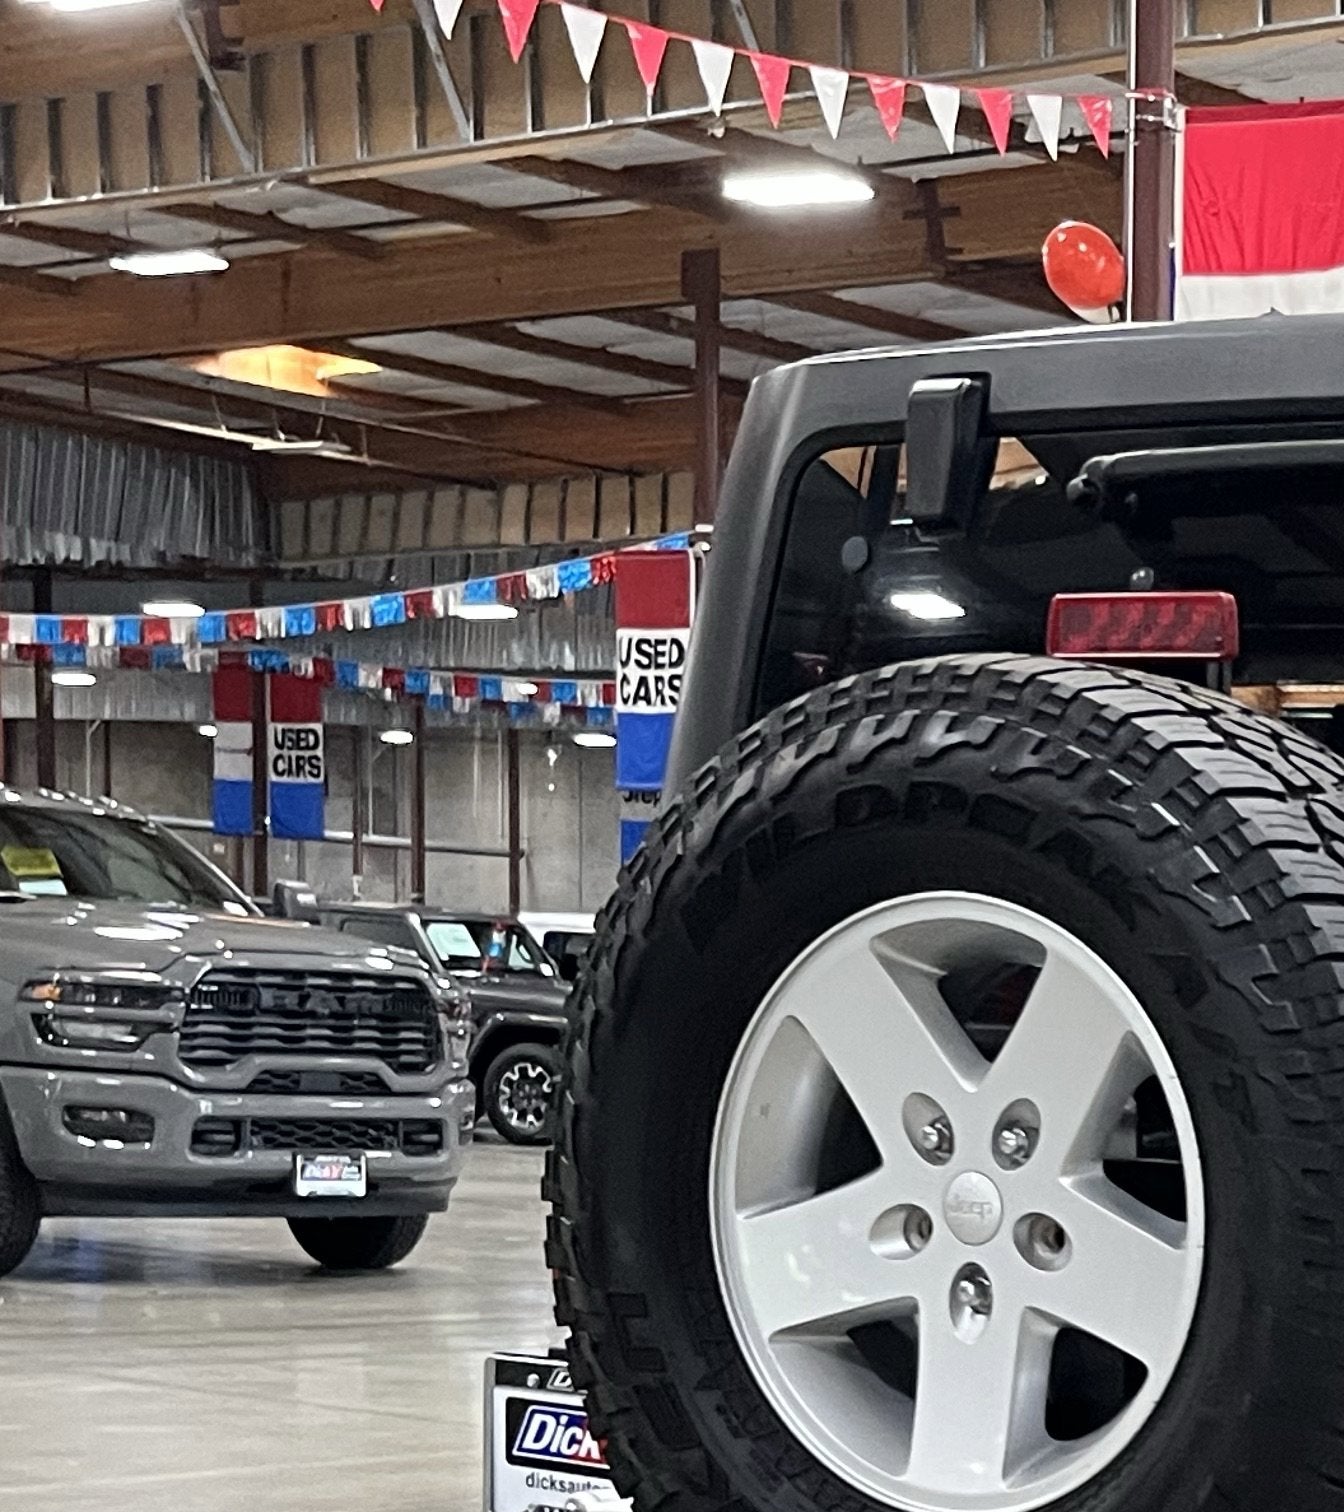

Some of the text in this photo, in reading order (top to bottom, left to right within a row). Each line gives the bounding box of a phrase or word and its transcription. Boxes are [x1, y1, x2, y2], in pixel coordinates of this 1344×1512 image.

[620, 637, 685, 669] USED
[620, 673, 682, 706] CARS
[274, 726, 320, 751] USED
[272, 753, 321, 778] CARS
